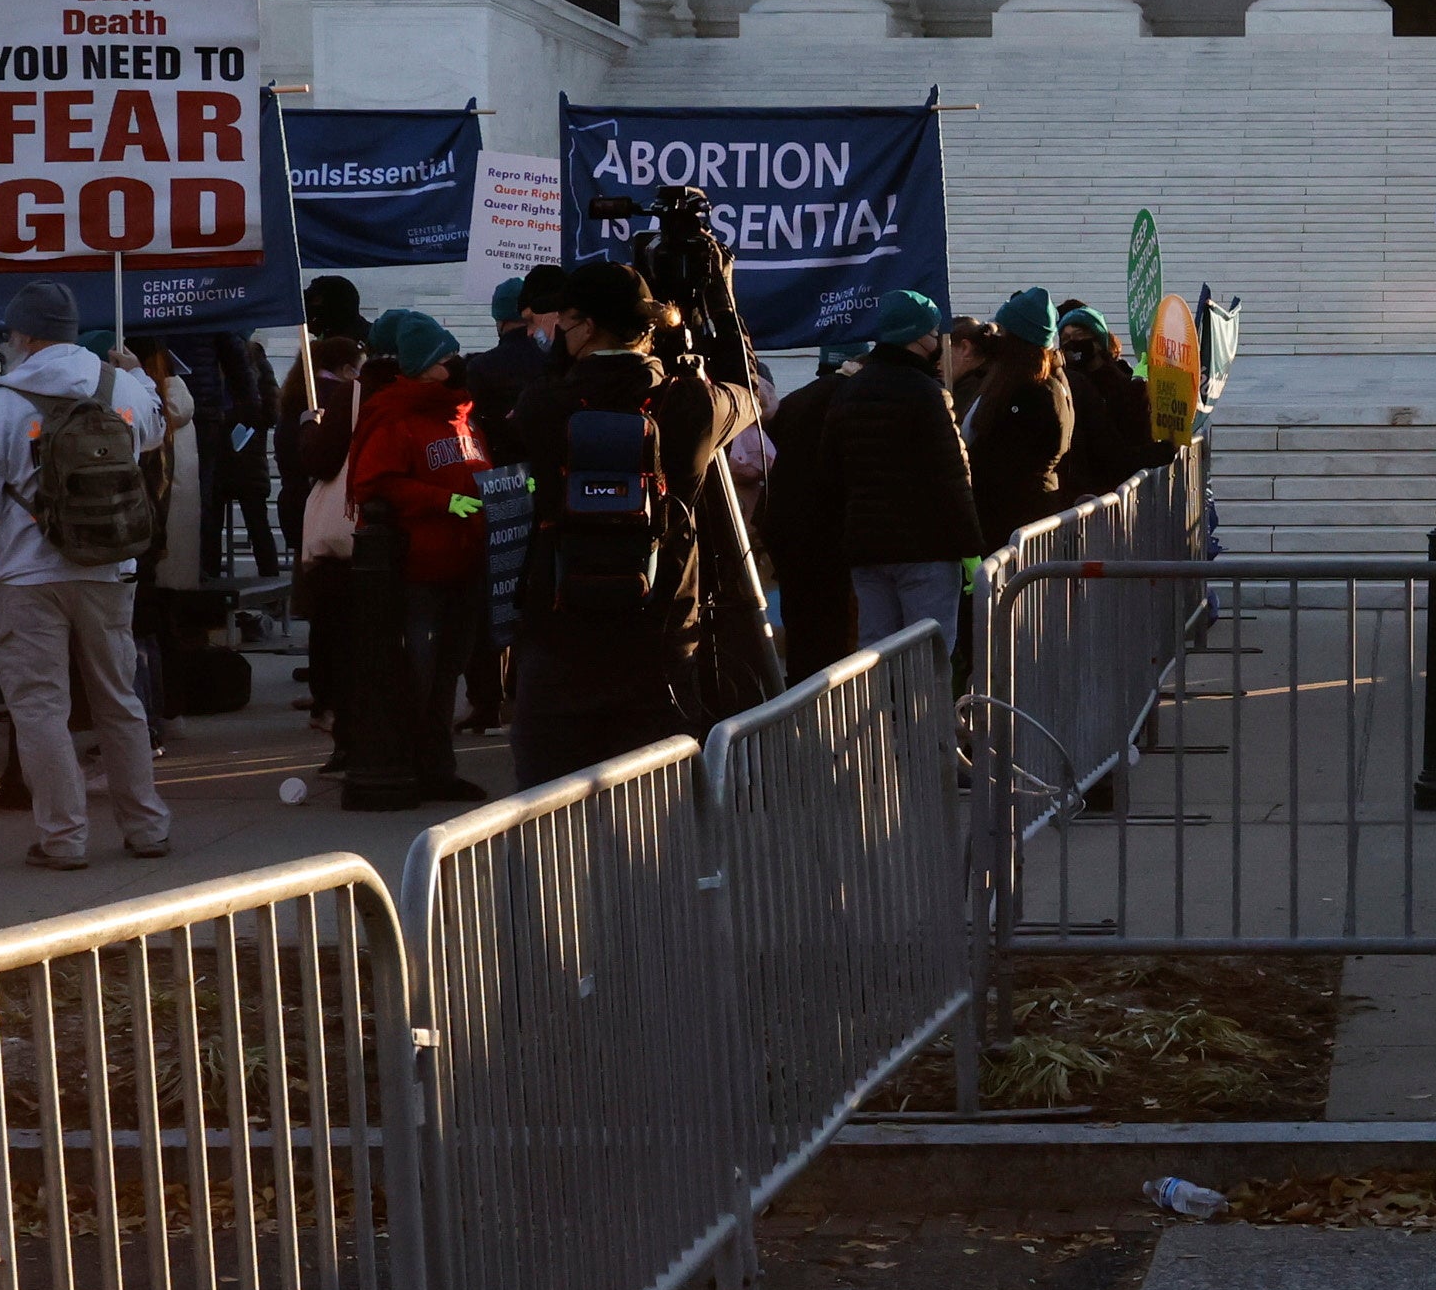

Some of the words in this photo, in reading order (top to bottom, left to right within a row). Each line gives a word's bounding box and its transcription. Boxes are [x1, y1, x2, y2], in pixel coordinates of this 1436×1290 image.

[63, 9, 166, 35] Death
[82, 45, 180, 80] NEED
[194, 46, 244, 82] TO
[593, 140, 851, 190] ABORTION
[488, 167, 520, 180] Repro
[524, 172, 558, 185] Rights
[494, 184, 528, 197] Queer
[484, 198, 518, 211] Queer
[521, 203, 555, 215] Rights
[407, 224, 443, 237] CENTER
[491, 215, 524, 228] Repro
[1132, 219, 1148, 255] KEEP
[485, 249, 531, 261] QUEERING
[533, 244, 551, 252] Text
[1128, 235, 1156, 292] ABORTION
[143, 278, 195, 293] CENTER
[1131, 283, 1146, 319] SAFE
[1144, 256, 1158, 283] AND
[143, 286, 245, 306] REPRODUCTIVE
[143, 305, 193, 319] RIGHTS
[815, 313, 852, 328] RIGHTS
[1156, 333, 1192, 365] LIBERATE
[1171, 398, 1188, 417] OUR
